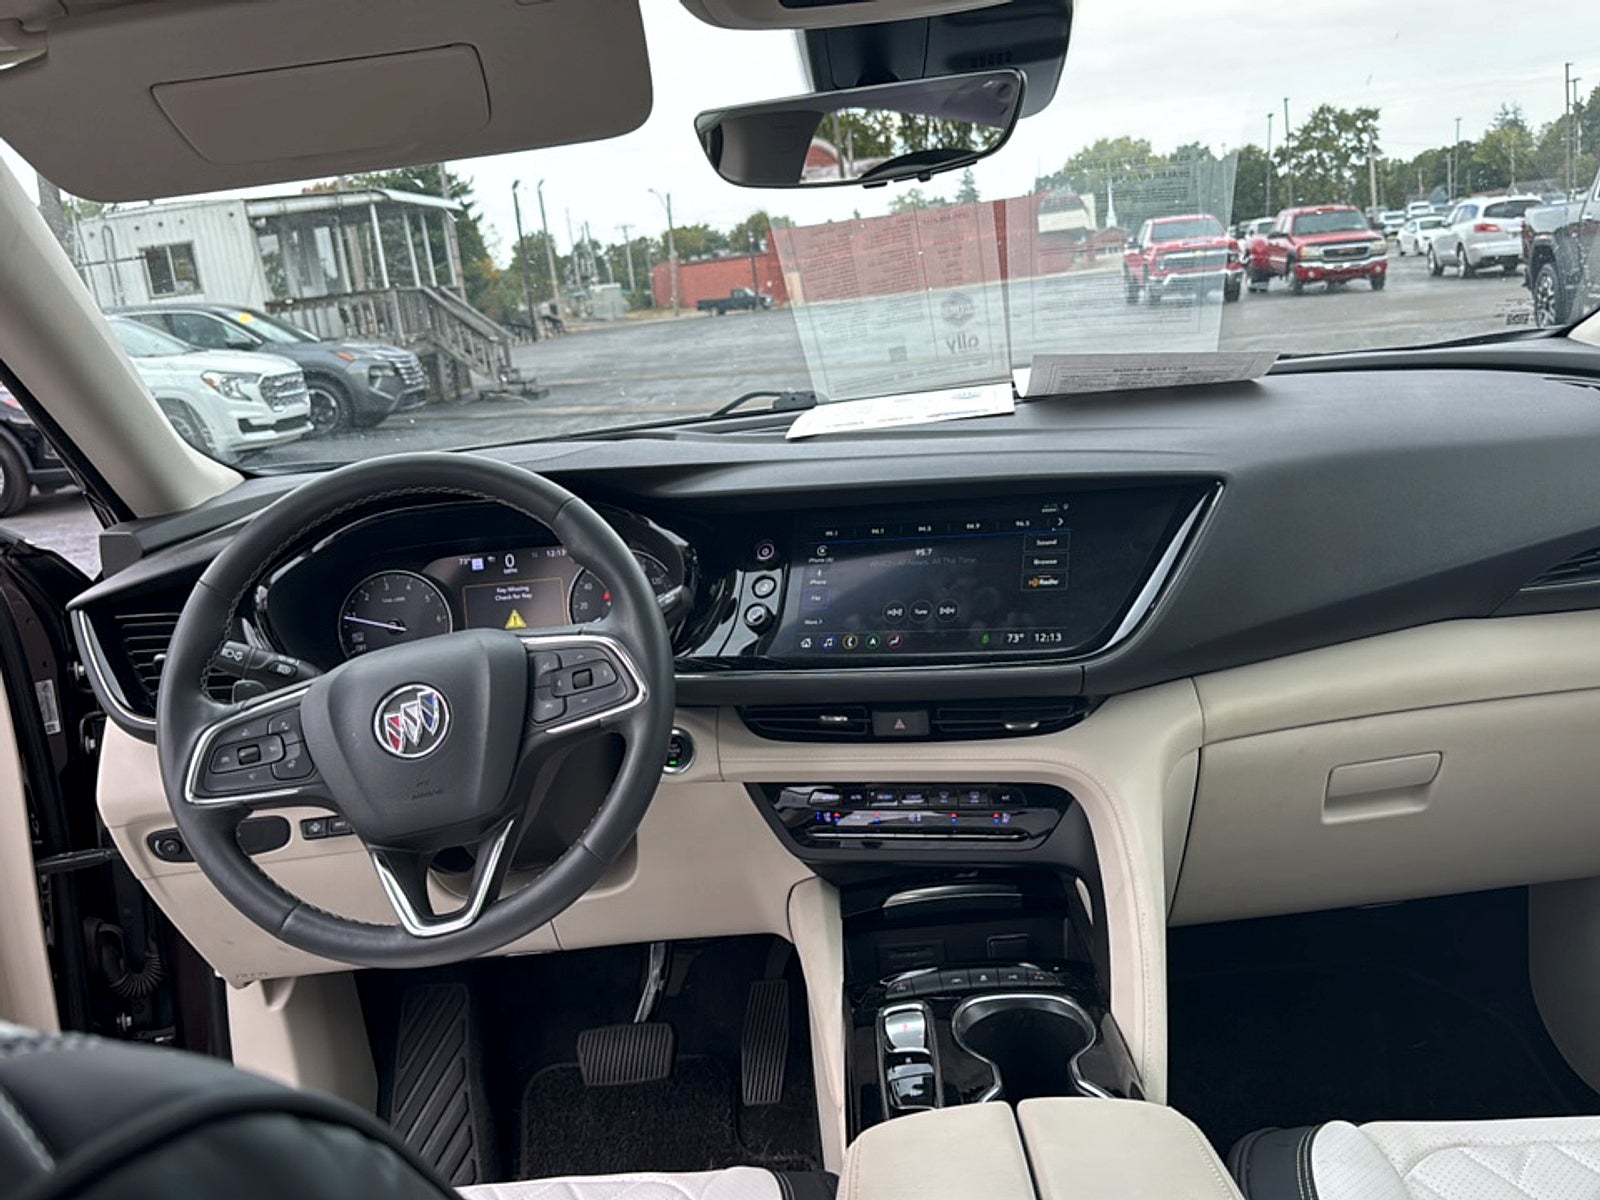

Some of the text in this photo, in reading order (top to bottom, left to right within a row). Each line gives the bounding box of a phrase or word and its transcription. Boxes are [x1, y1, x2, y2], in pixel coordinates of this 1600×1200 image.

[915, 548, 933, 556] 95.7
[504, 553, 515, 568] 0
[1034, 633, 1062, 643] 12:13
